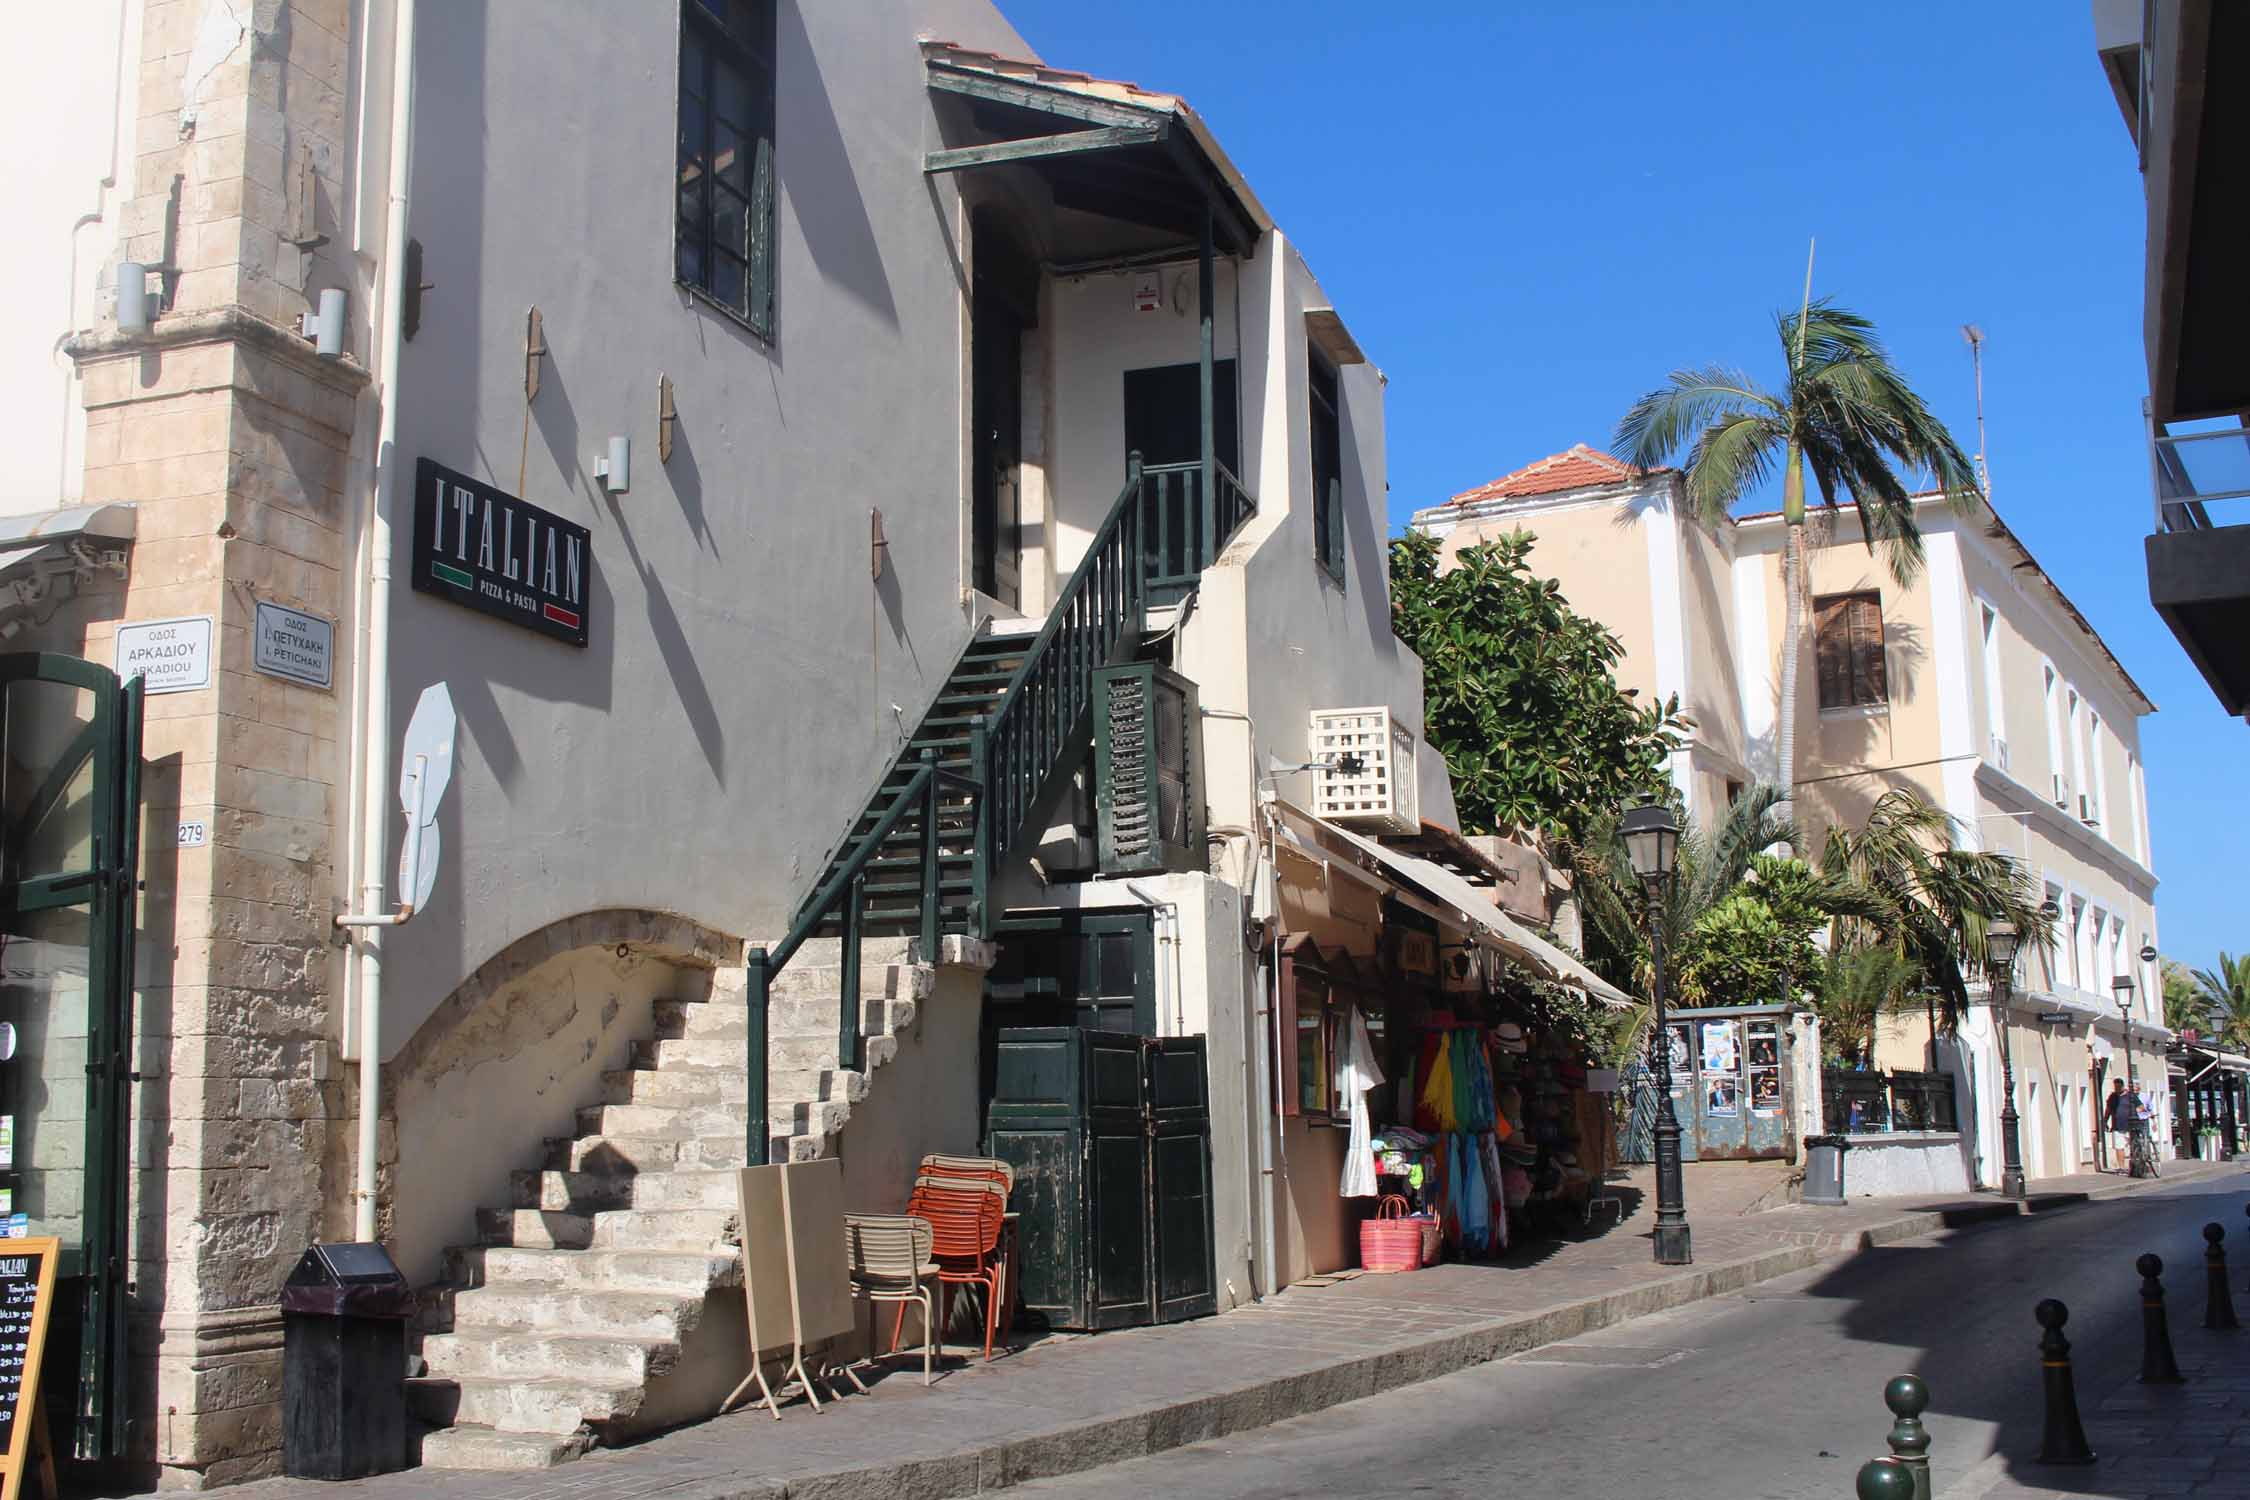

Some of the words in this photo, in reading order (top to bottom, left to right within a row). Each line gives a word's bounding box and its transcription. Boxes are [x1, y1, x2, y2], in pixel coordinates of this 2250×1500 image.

[432, 477, 582, 605] ITALIAN
[480, 579, 503, 601] PIZZA
[505, 589, 512, 603] &
[513, 592, 537, 613] PASTA
[284, 617, 307, 632] ΟΔΟΣ
[148, 629, 177, 641] ΟΔΟΣ
[273, 630, 324, 654] ΠΕΤΥΧΑΚΗ
[128, 642, 196, 661] ΑΡΚΑΔΙΟΥ
[273, 648, 322, 669] PETICHAKI
[179, 824, 203, 842] 279
